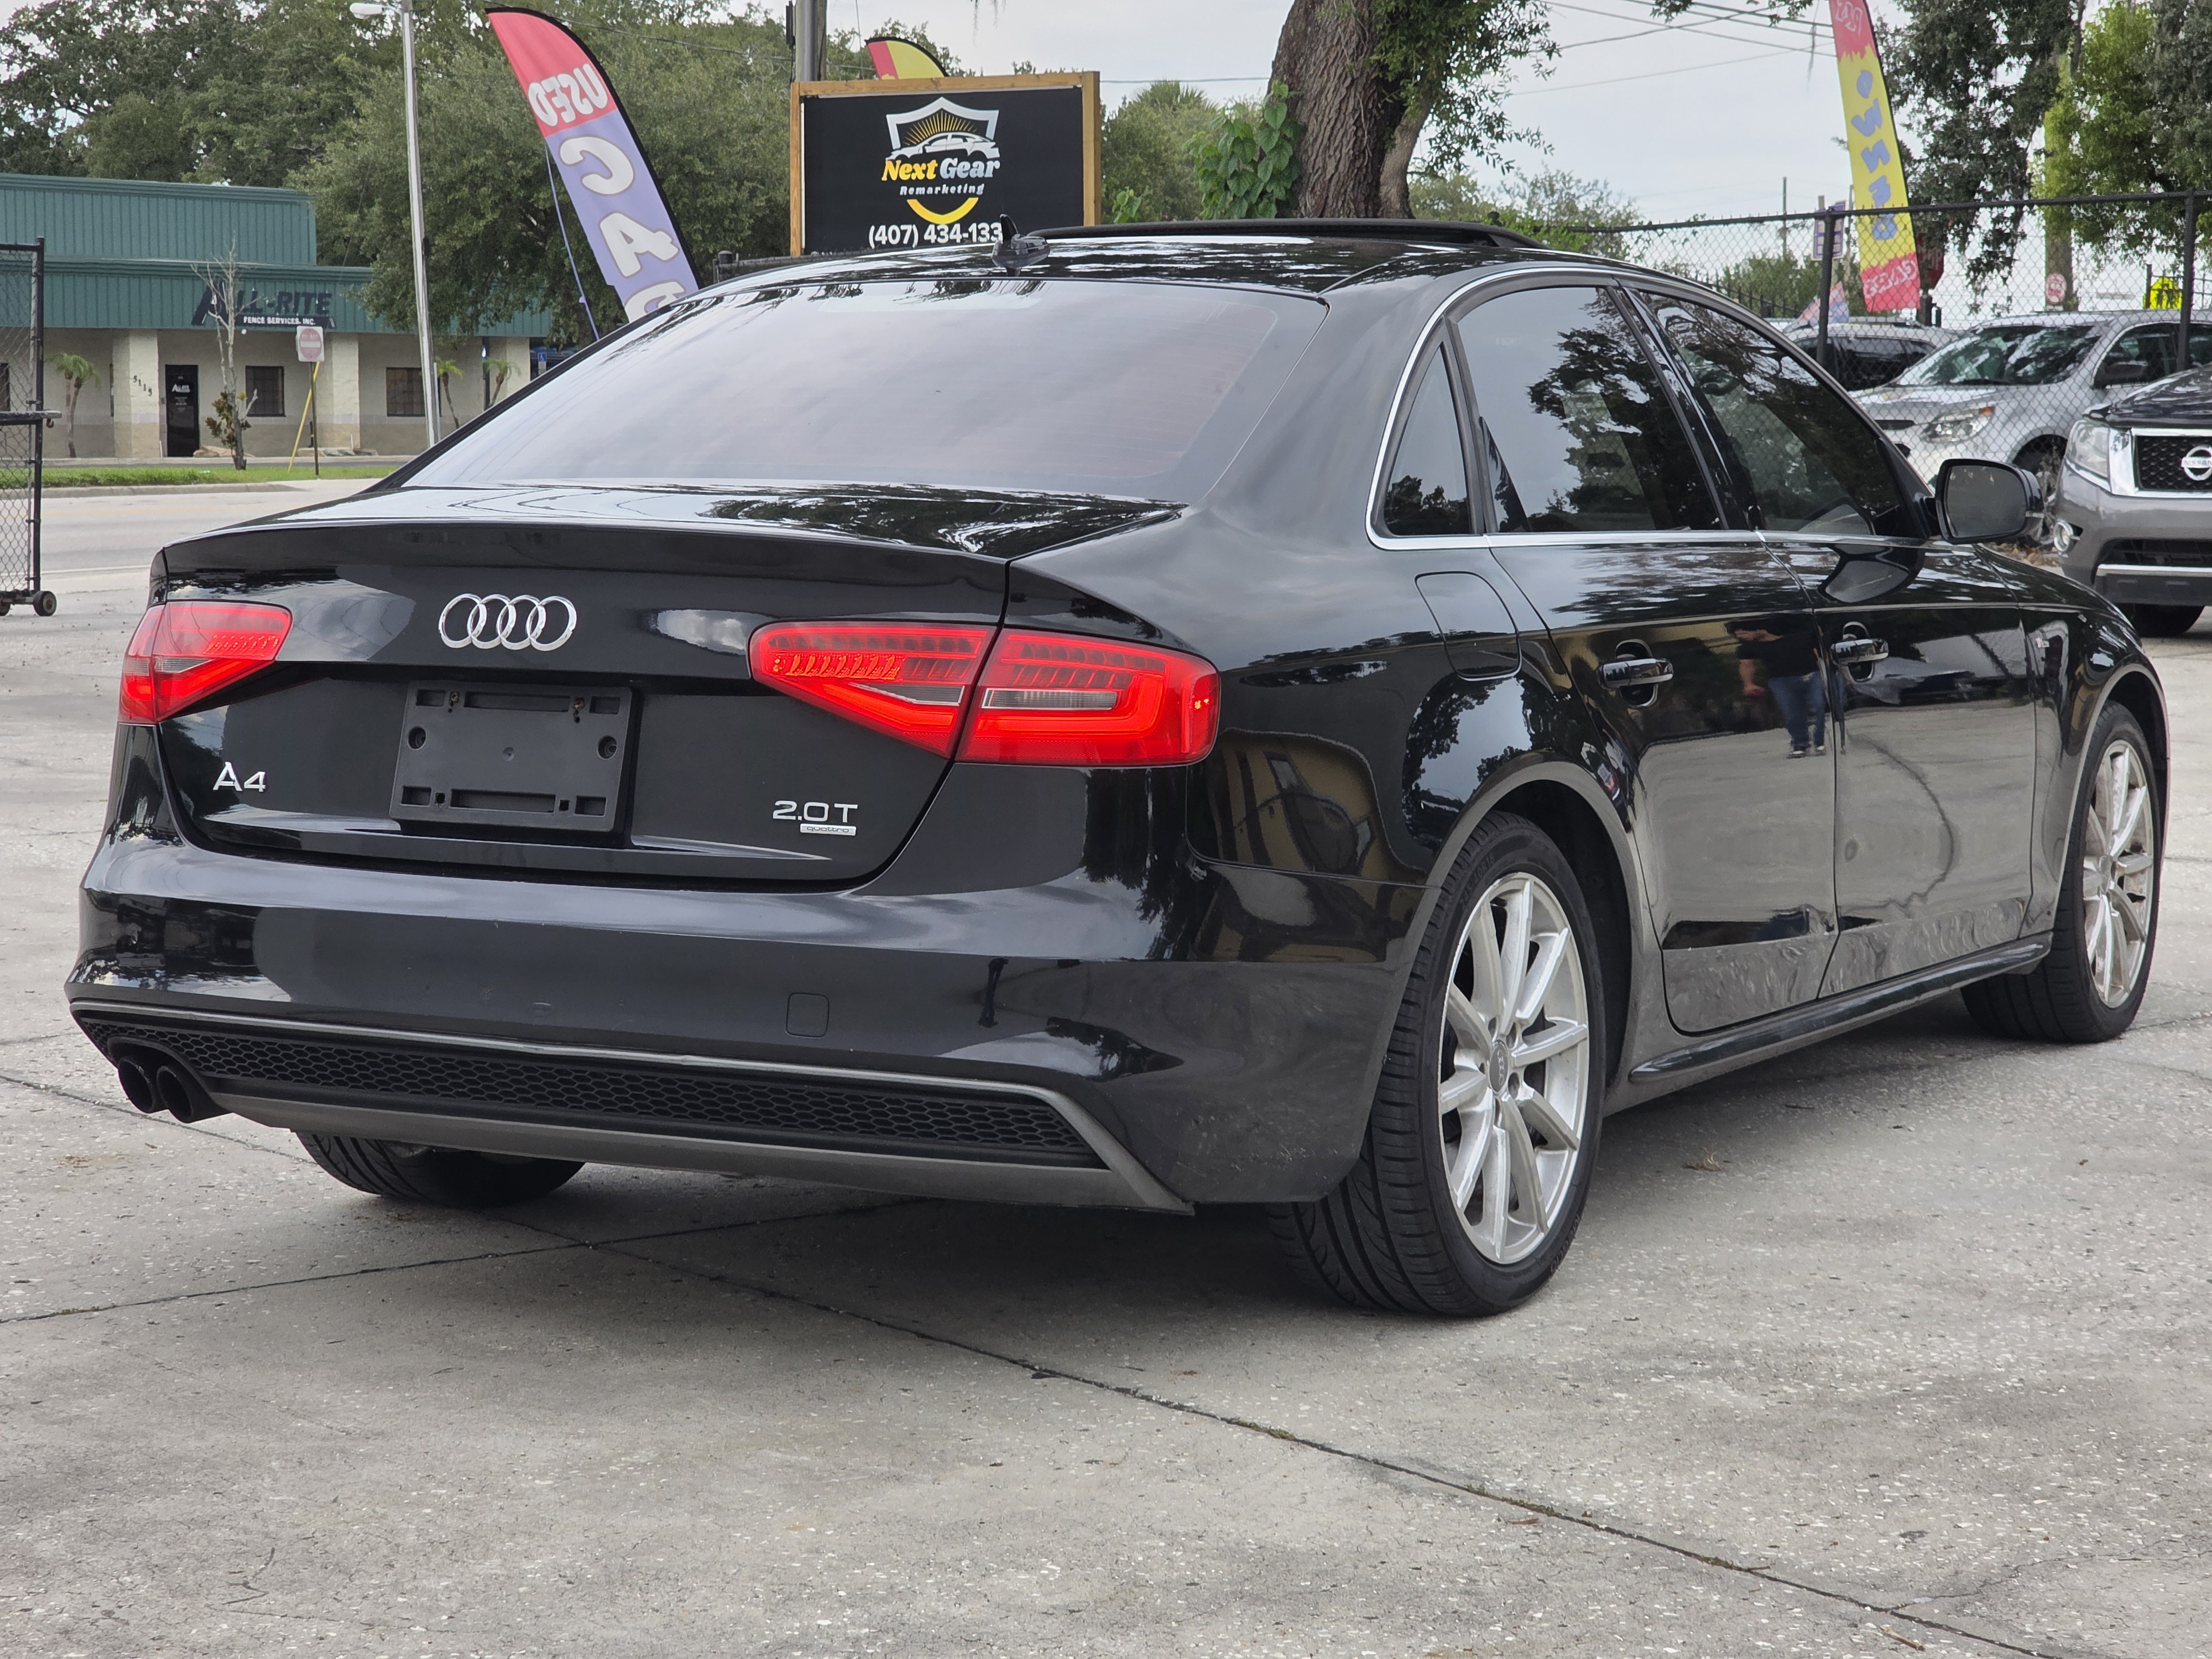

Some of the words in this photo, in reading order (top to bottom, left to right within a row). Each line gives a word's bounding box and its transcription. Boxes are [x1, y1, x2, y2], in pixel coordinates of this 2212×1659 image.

[881, 159, 938, 181] Next
[940, 158, 1000, 179] Gear
[900, 183, 985, 195] Remarketing
[869, 225, 919, 249] (407)
[924, 223, 1003, 243] 434-133
[243, 316, 265, 324] FENCE
[213, 761, 266, 792] A4
